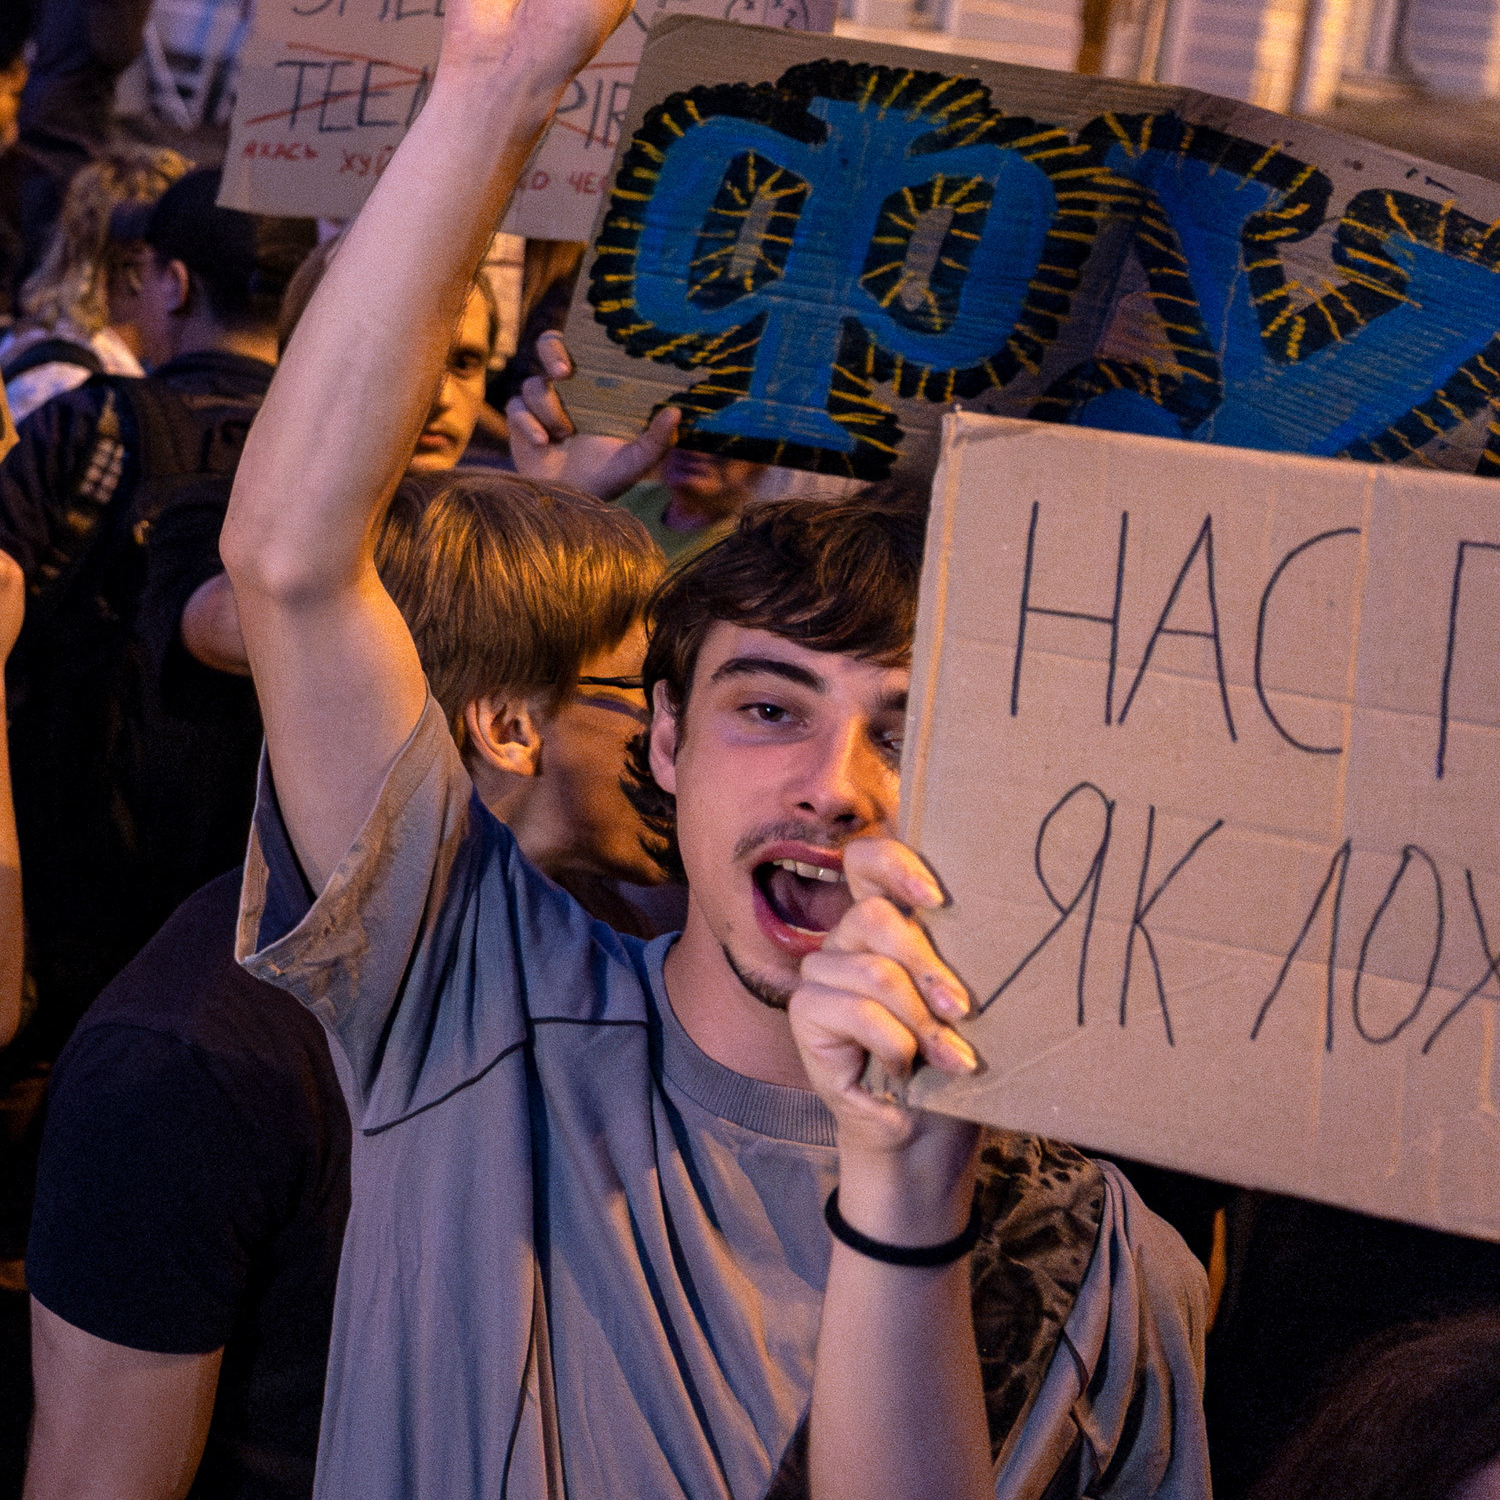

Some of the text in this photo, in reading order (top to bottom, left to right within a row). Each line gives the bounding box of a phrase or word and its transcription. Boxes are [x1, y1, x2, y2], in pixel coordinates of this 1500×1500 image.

[1010, 501, 1361, 756] НАС
[978, 781, 1500, 1055] ЯК ЛОХ
